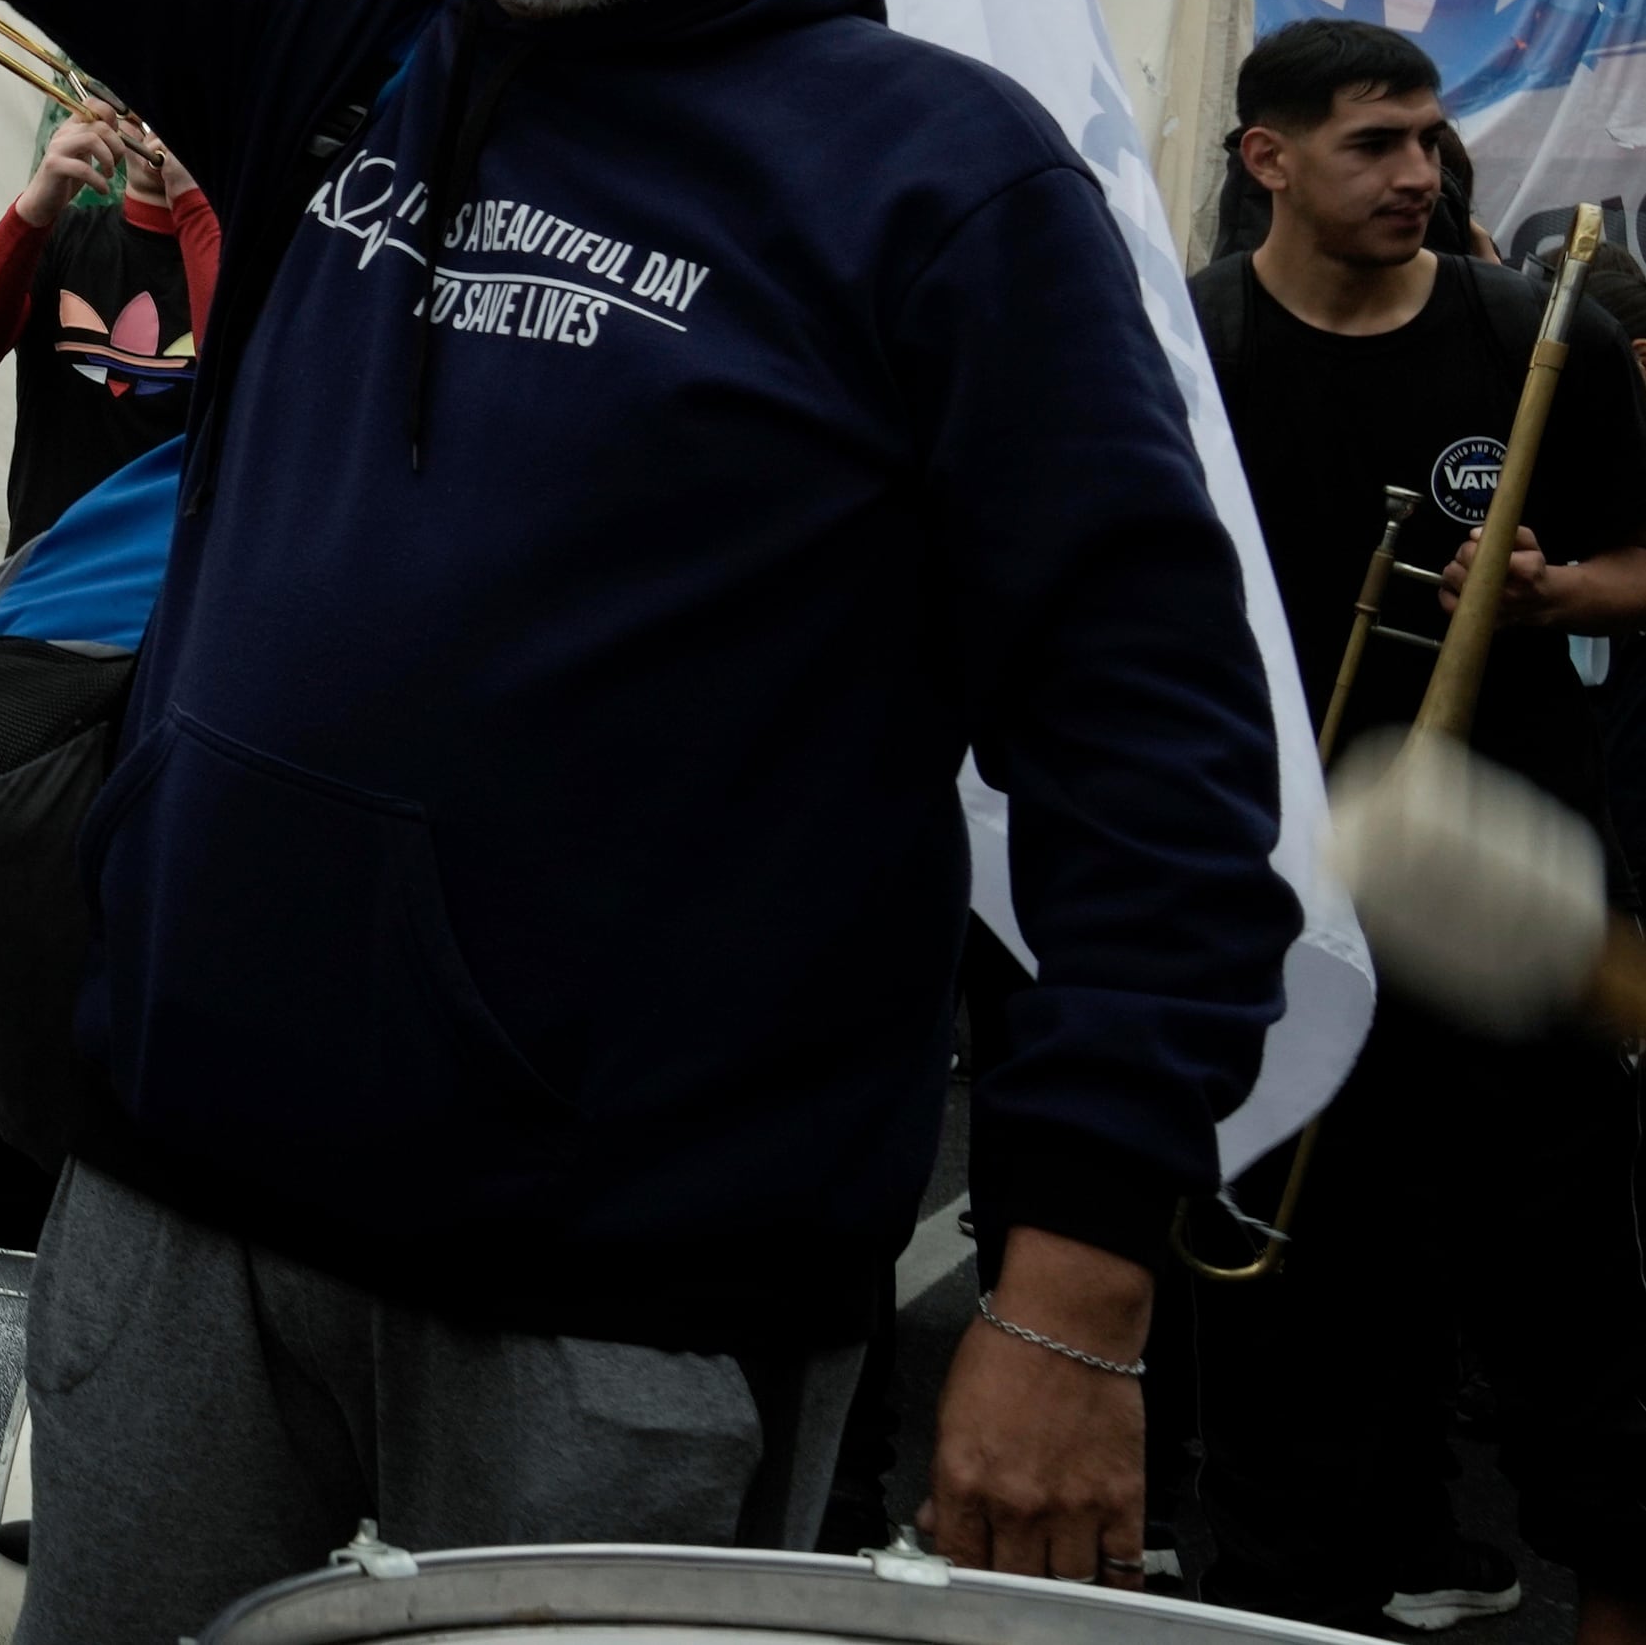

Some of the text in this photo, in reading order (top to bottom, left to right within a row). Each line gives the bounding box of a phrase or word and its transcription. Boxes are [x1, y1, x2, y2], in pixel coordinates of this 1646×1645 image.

[482, 201, 633, 284] BEAUTIFUL
[631, 251, 709, 313] DAY
[453, 282, 522, 335] SAVE
[518, 285, 609, 347] LIVES
[1444, 465, 1502, 490] VAN
